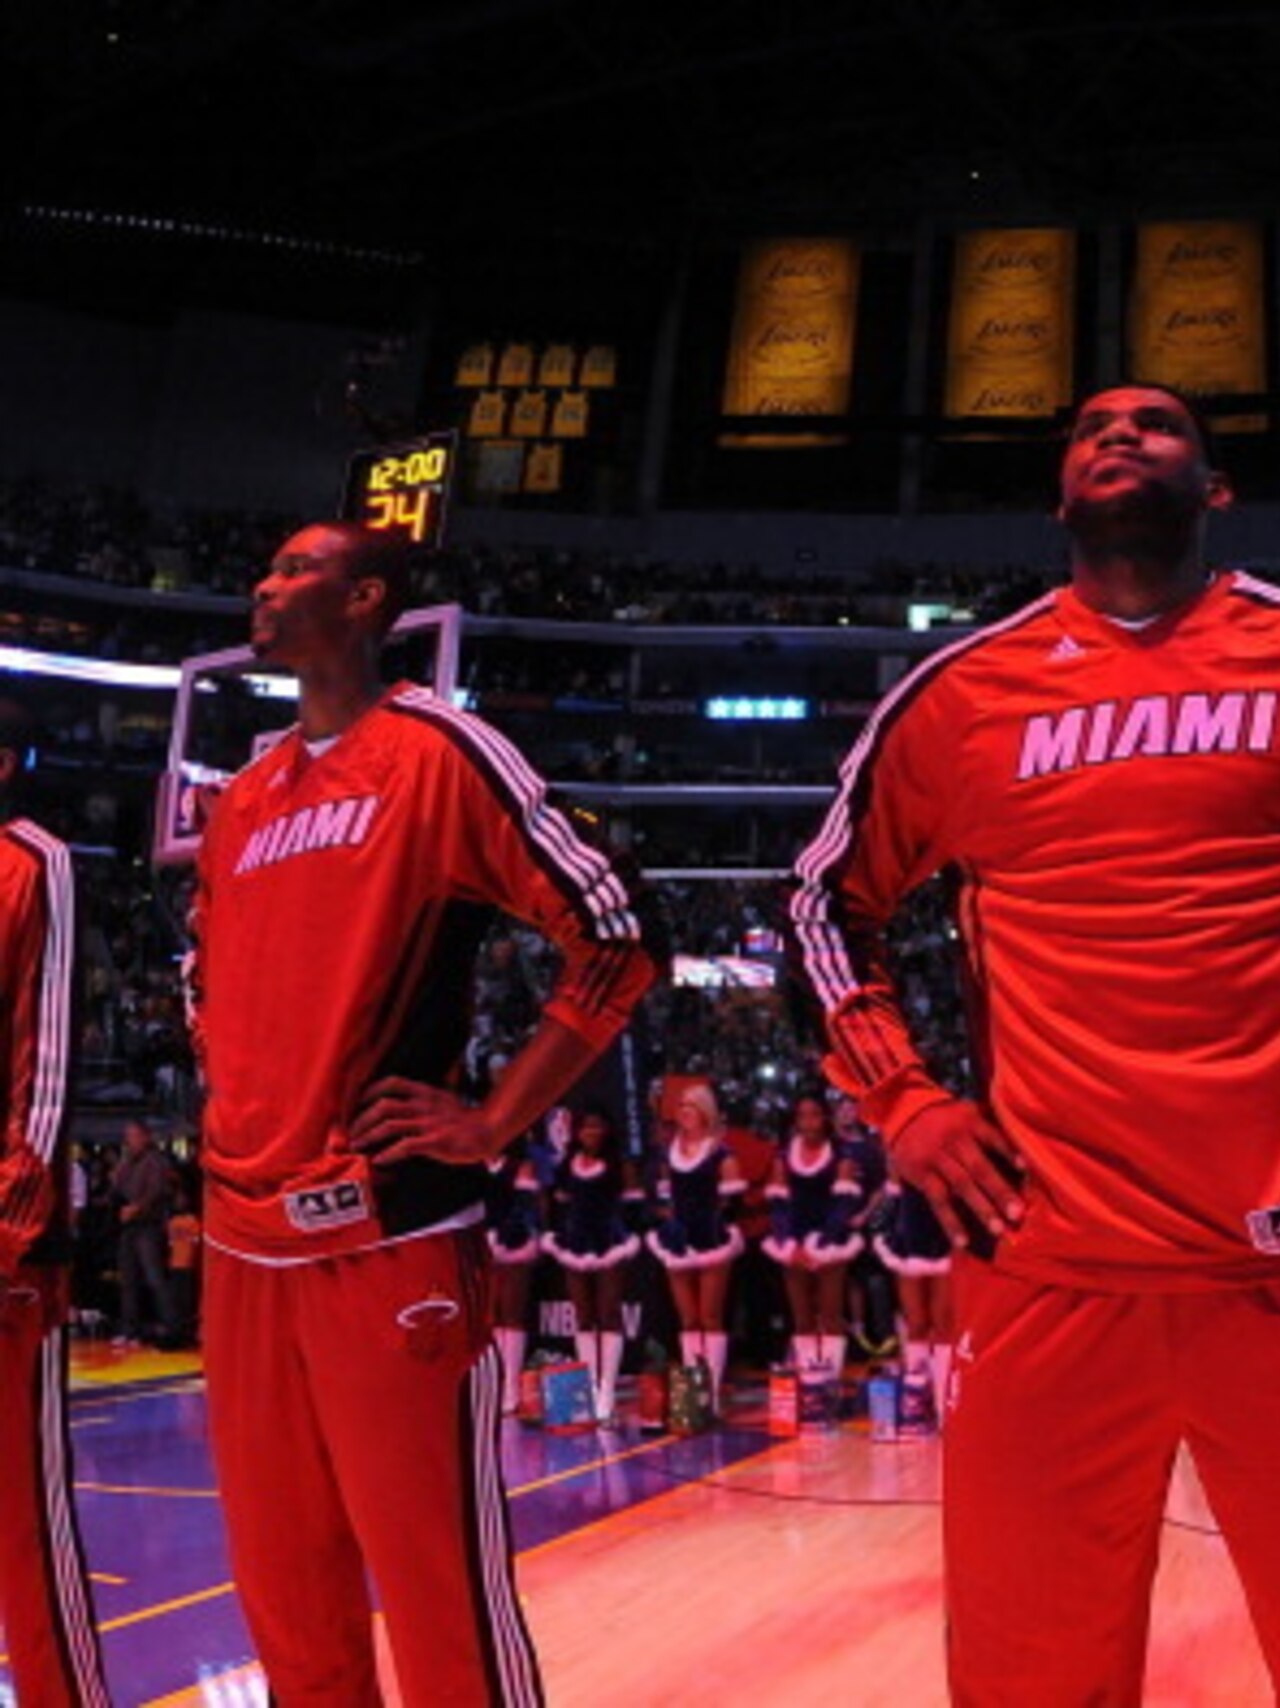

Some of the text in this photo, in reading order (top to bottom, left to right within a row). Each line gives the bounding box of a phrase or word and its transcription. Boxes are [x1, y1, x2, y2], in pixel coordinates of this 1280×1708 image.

[367, 447, 447, 490] 12:00
[1015, 690, 1278, 781] MIAMI
[233, 795, 379, 876] MIAMI
[538, 1300, 644, 1340] NB V
